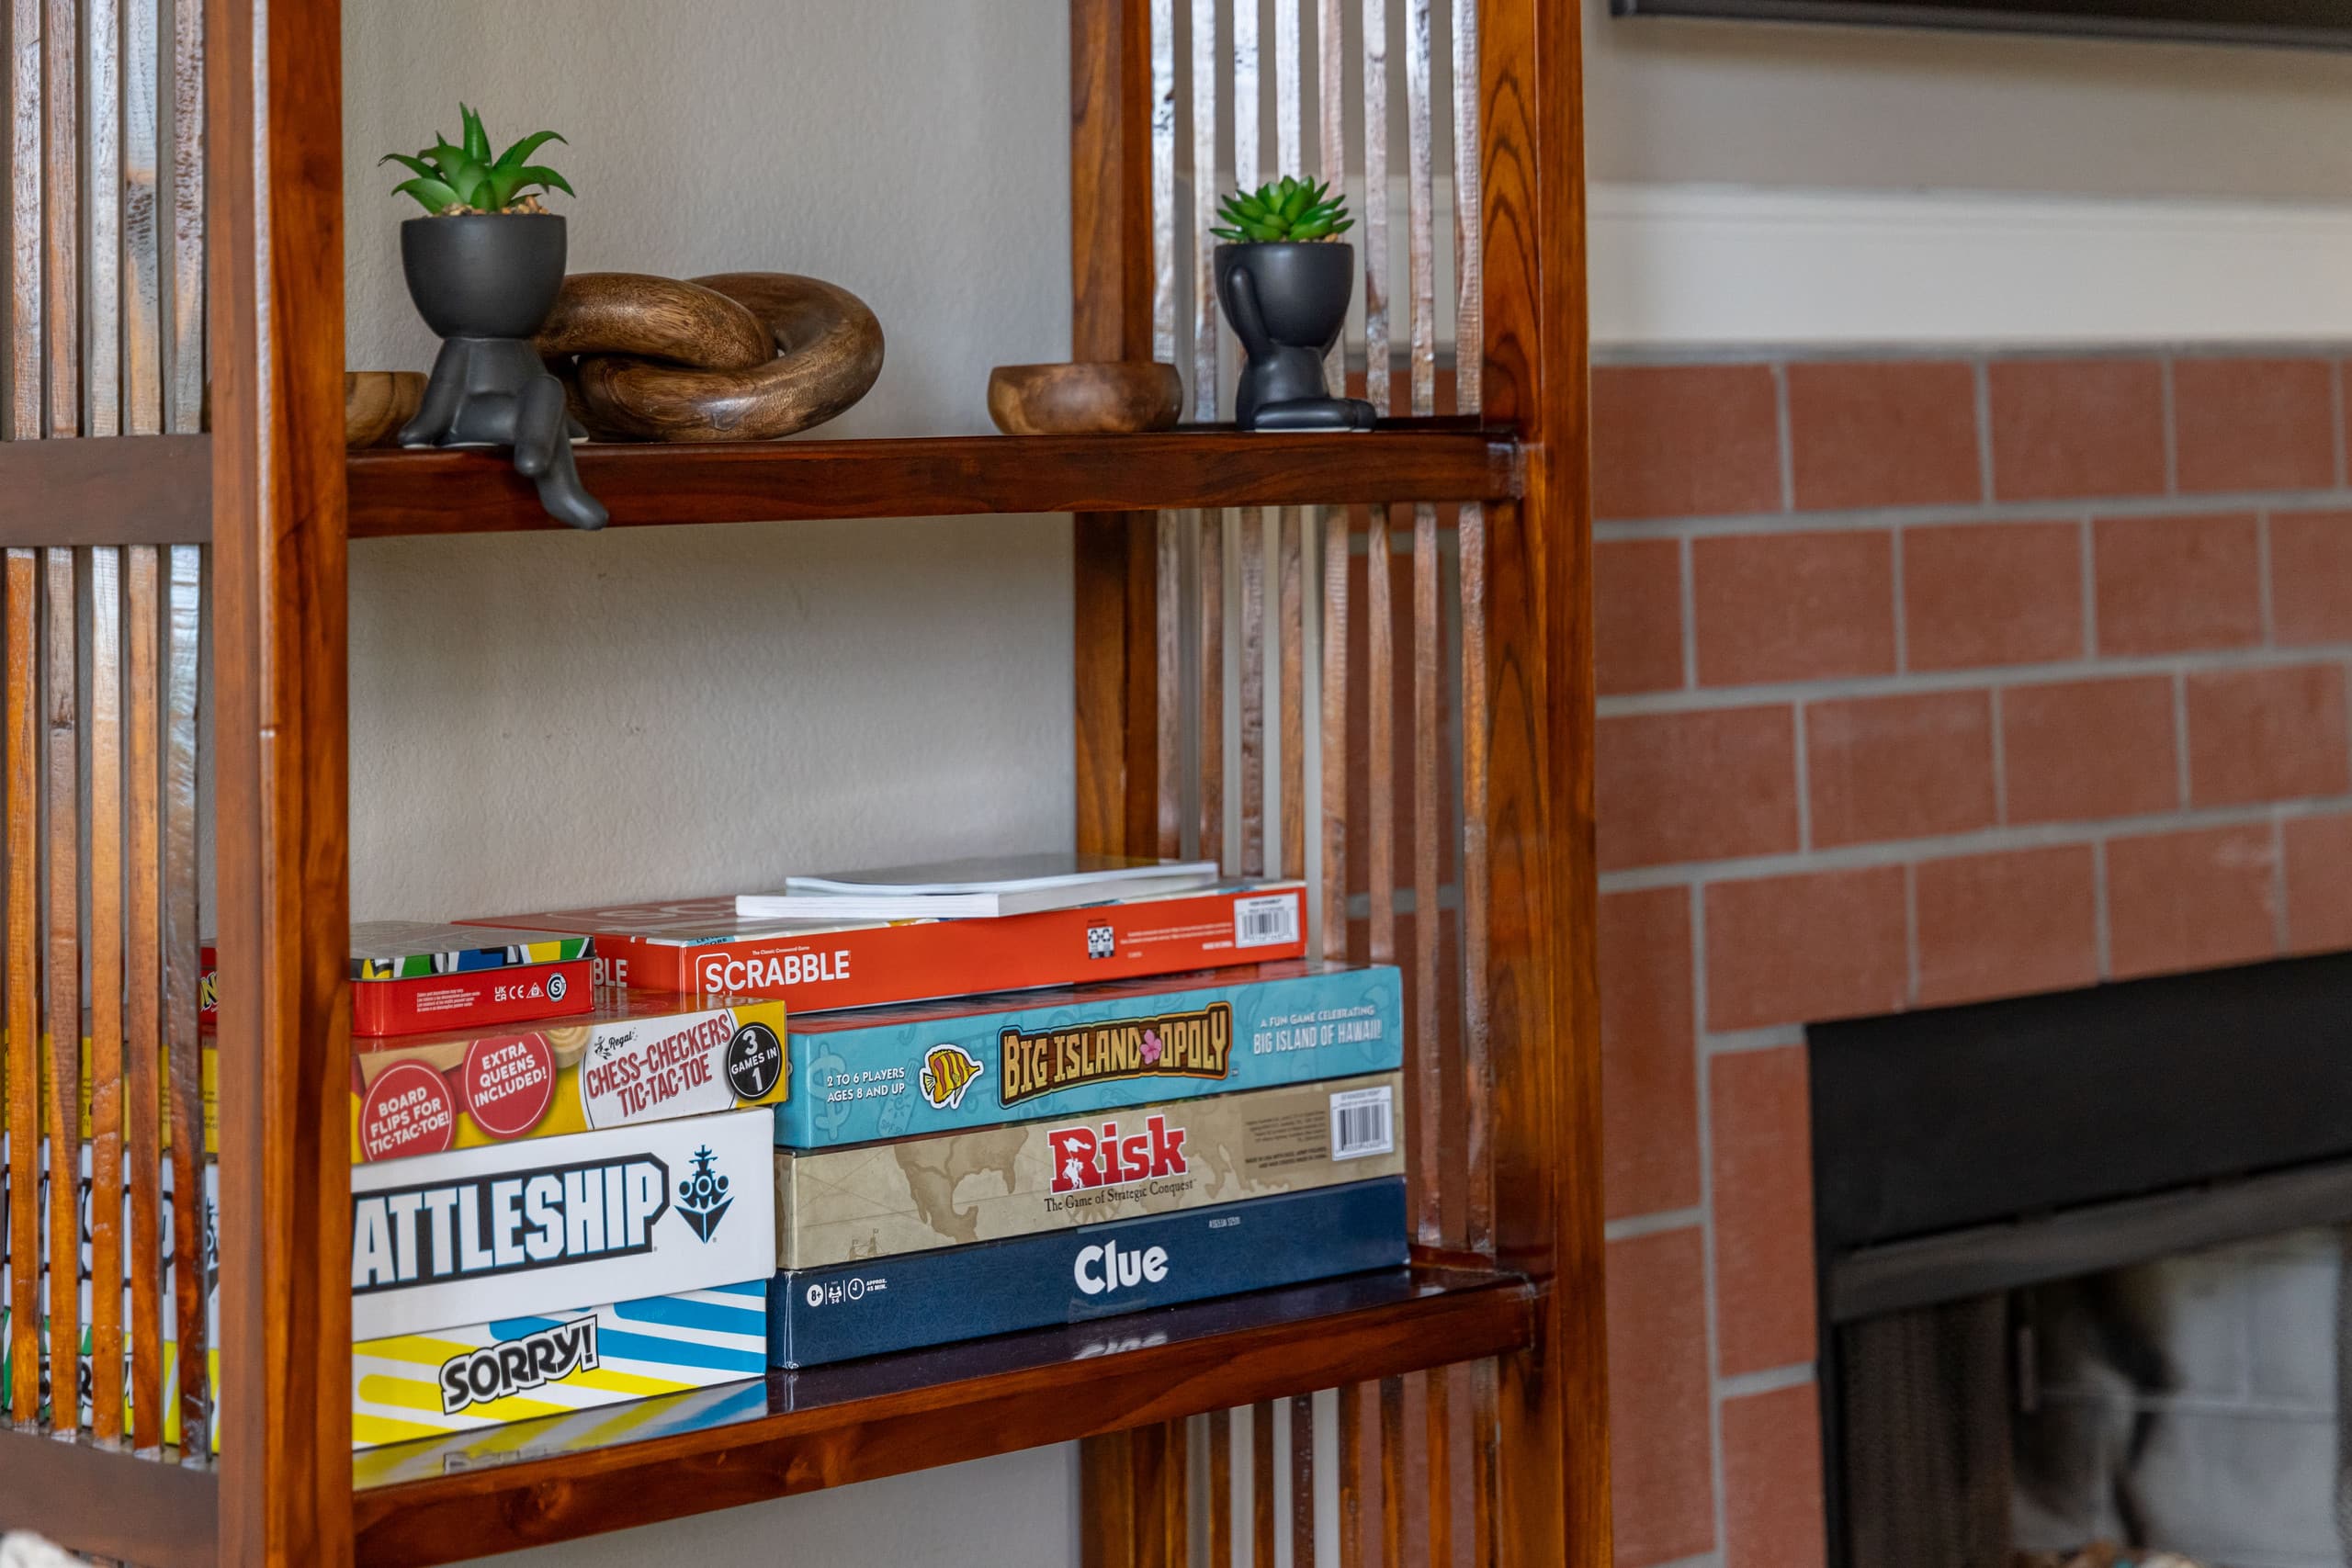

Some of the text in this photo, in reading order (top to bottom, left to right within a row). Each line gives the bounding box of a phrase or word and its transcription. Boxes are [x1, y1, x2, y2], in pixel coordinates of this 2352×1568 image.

[705, 950, 851, 994] SCRABBLE
[1261, 1005, 1375, 1028] A FUN GAME CELEBRATING
[482, 1042, 527, 1070] EXTRA
[586, 1013, 731, 1100] CHESS-CHECKERS
[608, 1030, 633, 1051] Regal
[743, 1030, 758, 1055] 3
[1003, 1010, 1227, 1100] BIG ISLAND OPOLY
[1253, 1032, 1272, 1055] BIG
[1276, 1029, 1317, 1052] ISLAND
[1320, 1026, 1334, 1046] OF
[480, 1055, 536, 1088] QUEENS
[731, 1047, 777, 1076] GAMES IN
[828, 1067, 905, 1087] 2 TO 6 PLAYERS
[474, 1066, 547, 1107] INCLUDED!
[616, 1053, 713, 1118] TIC-TAC-TOE
[752, 1068, 763, 1093] 1
[828, 1083, 905, 1102] AGES 8 AND UP
[370, 1098, 441, 1137] FLIPS FOR
[378, 1087, 427, 1116] BOARD
[369, 1111, 450, 1156] TIC-TAC-TOE!
[1048, 1115, 1187, 1193] Risk
[1045, 1180, 1193, 1212] The Game of Strategic Conquest
[353, 1161, 663, 1288] ATTLESHIP
[1073, 1240, 1169, 1294] Clue
[811, 1290, 821, 1302] 8+
[442, 1318, 596, 1410] SORRY!
